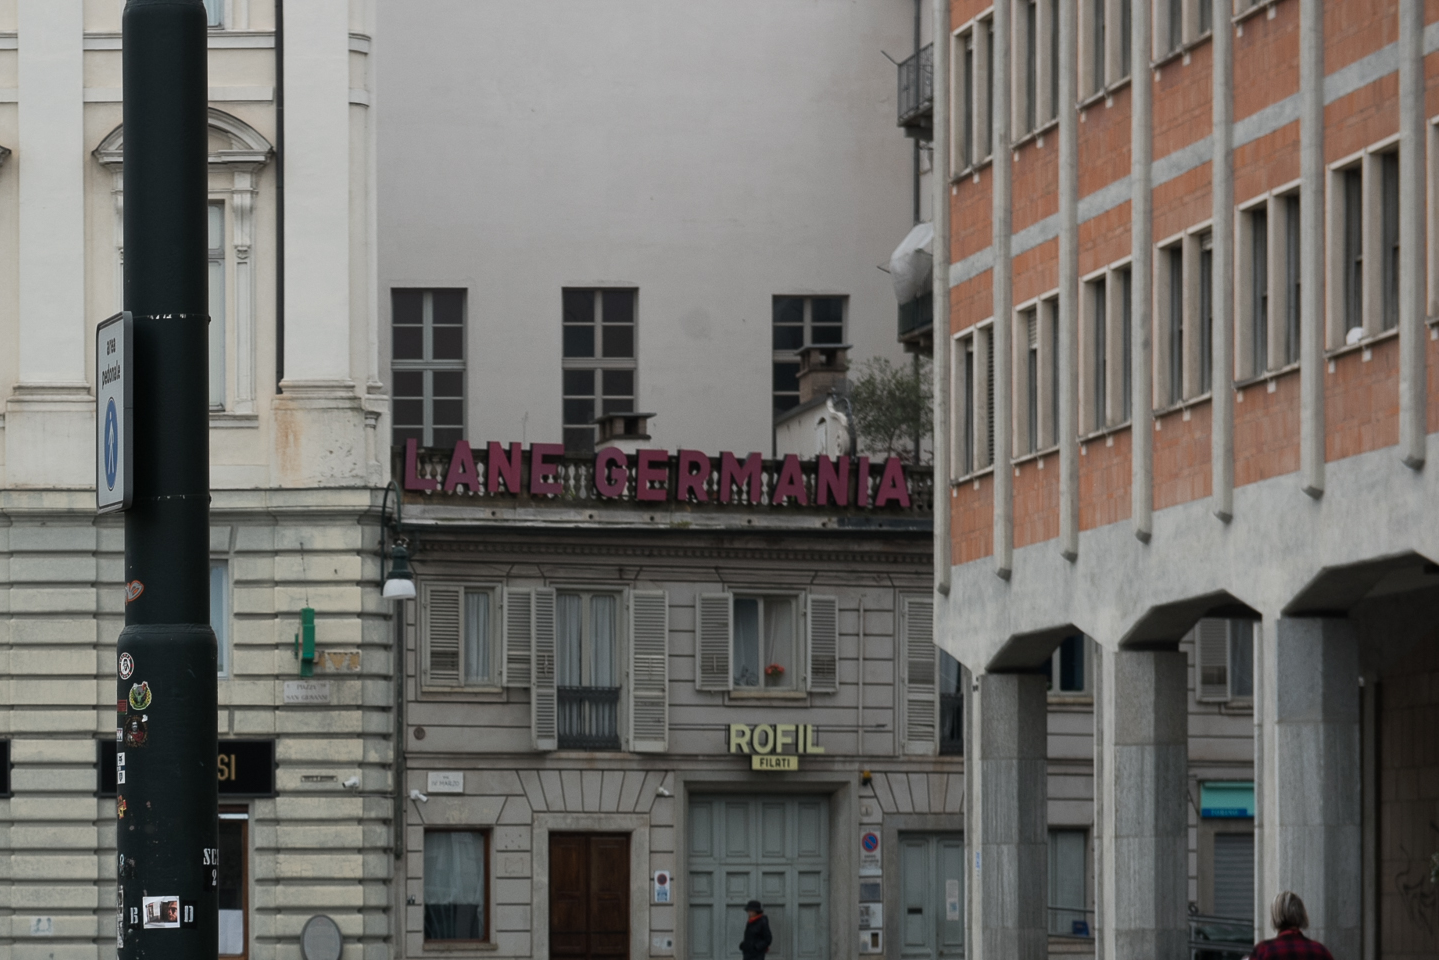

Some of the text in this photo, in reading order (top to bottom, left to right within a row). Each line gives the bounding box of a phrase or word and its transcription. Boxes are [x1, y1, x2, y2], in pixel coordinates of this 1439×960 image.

[106, 337, 116, 356] area
[102, 360, 121, 390] pedonale
[404, 437, 911, 508] LANE GERMANIA
[729, 723, 825, 754] ROFIL
[217, 754, 236, 781] SI
[759, 757, 791, 769] FILATI
